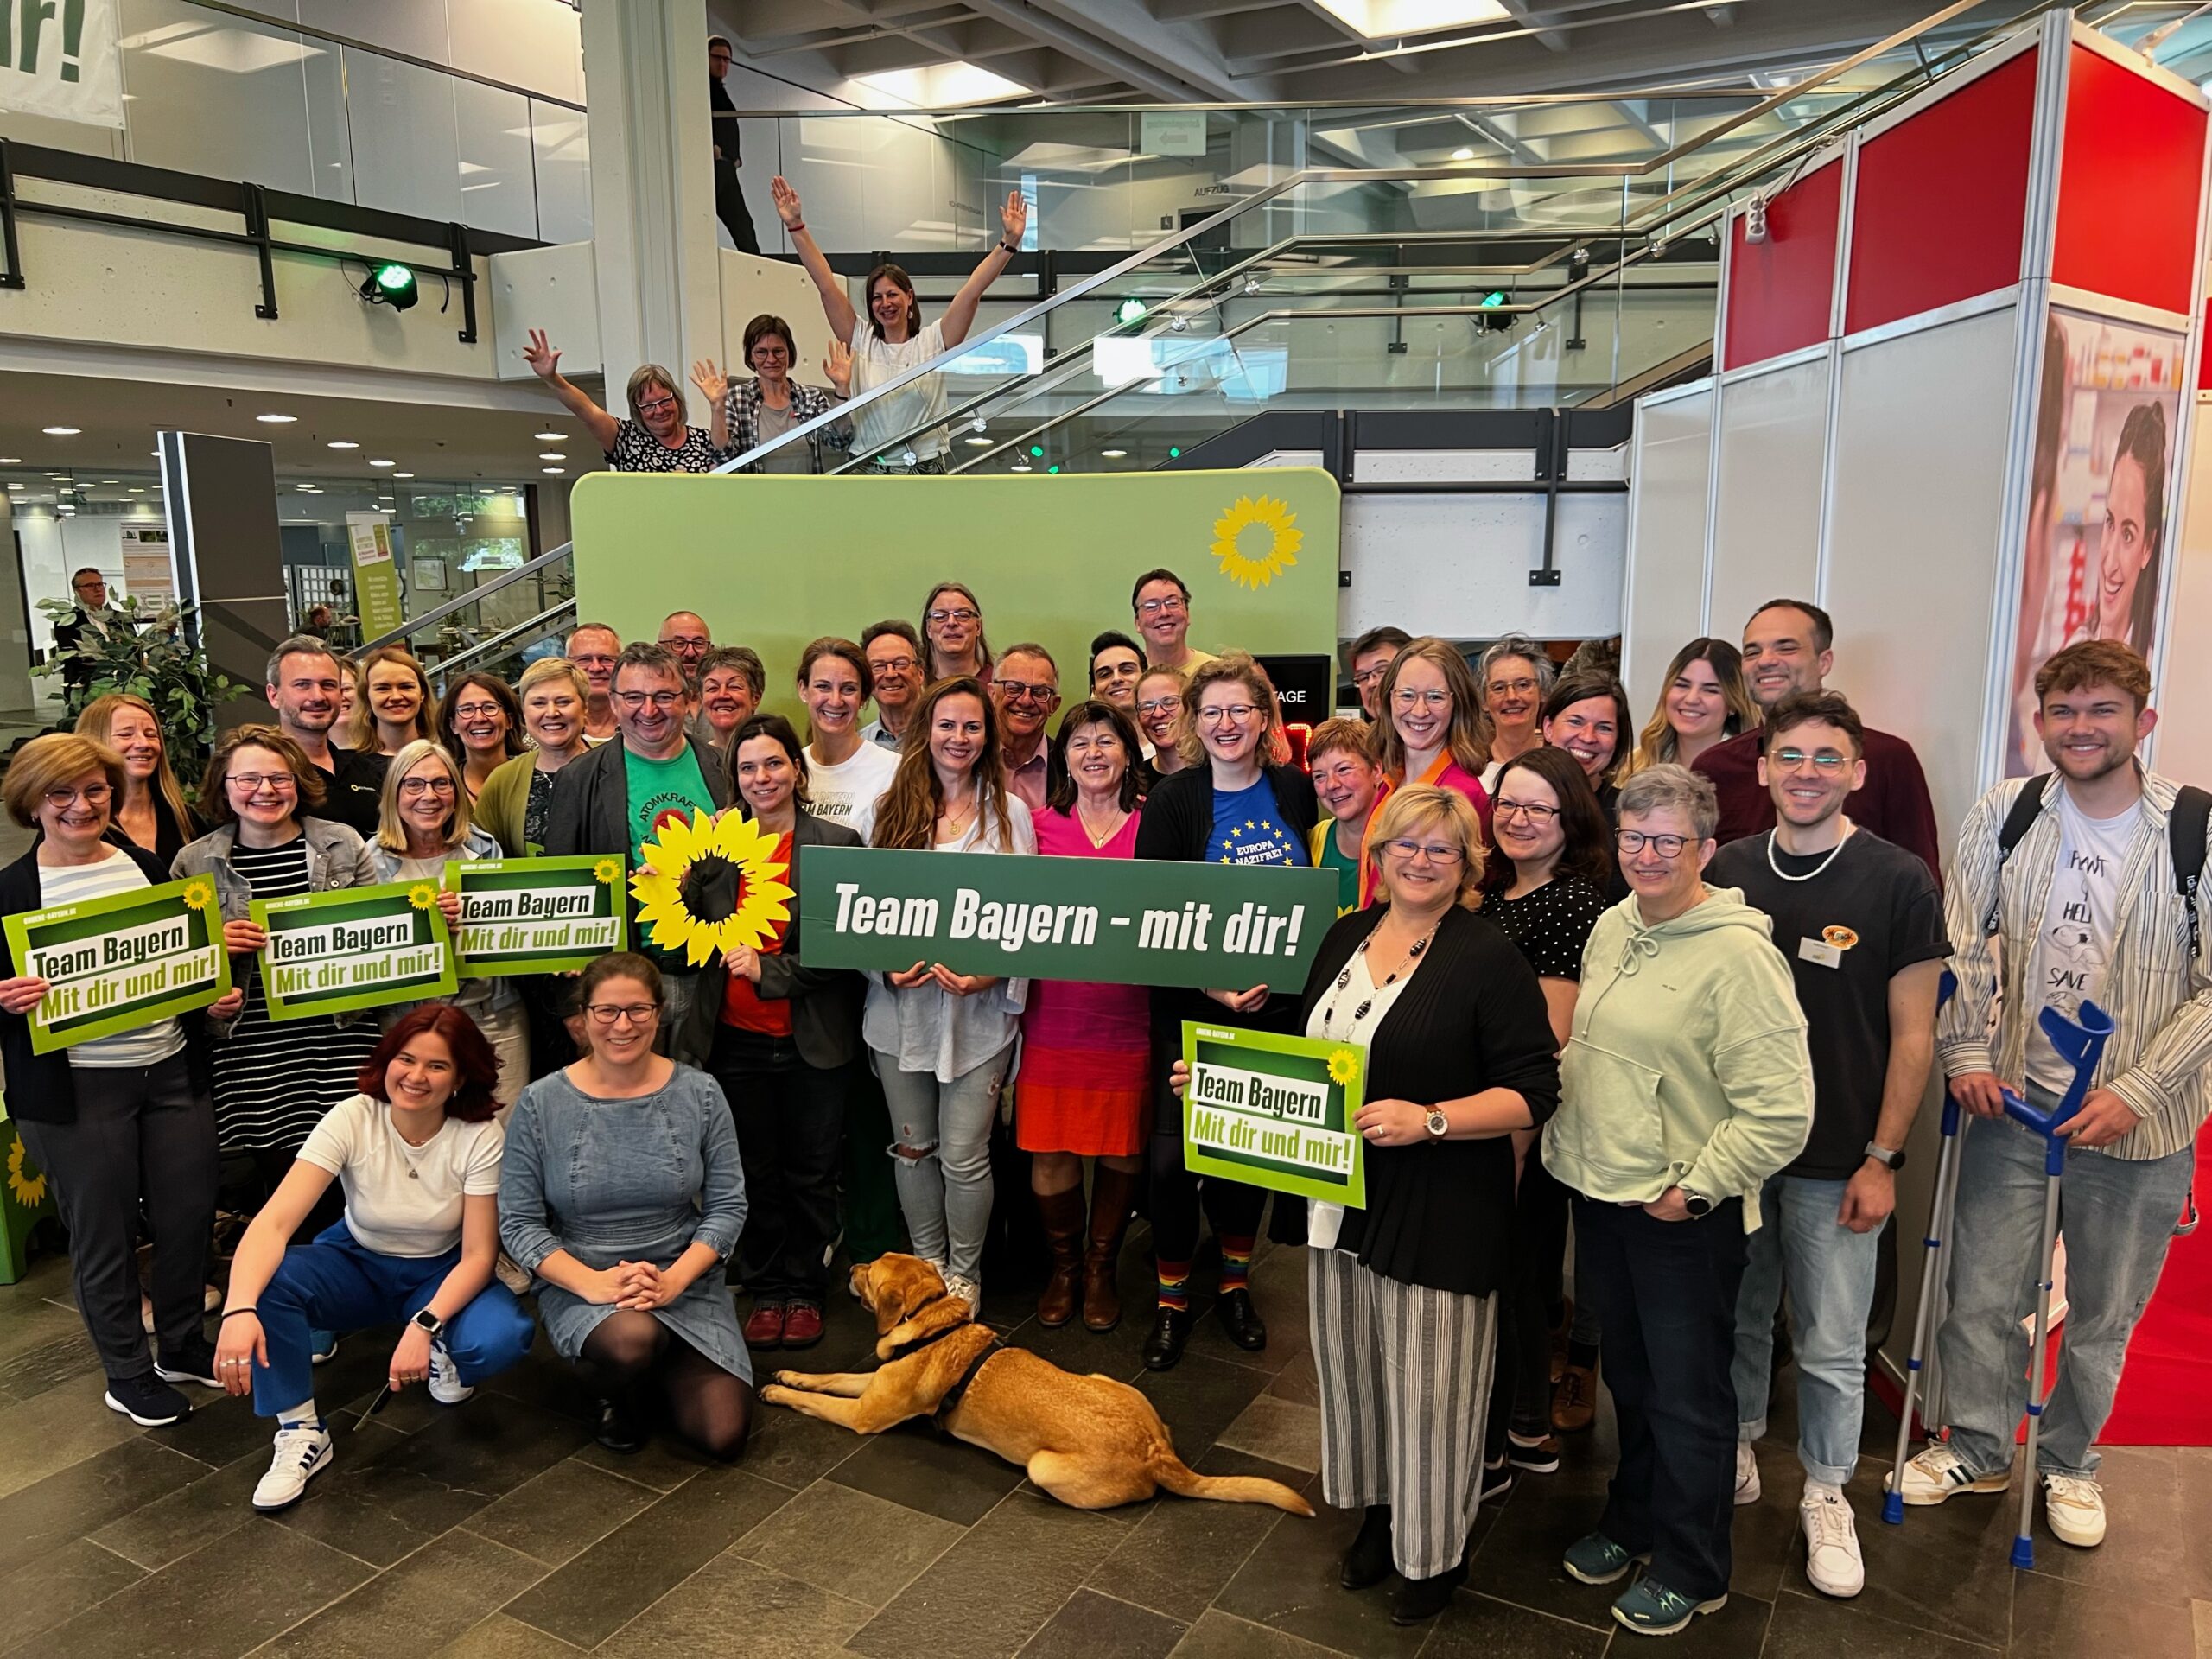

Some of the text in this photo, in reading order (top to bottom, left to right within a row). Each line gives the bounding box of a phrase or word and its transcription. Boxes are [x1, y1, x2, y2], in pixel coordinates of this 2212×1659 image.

[1194, 184, 1229, 196] AUFZUG
[817, 804, 853, 816] BAYERN
[1235, 849, 1283, 864] NAZIFREI
[1236, 840, 1274, 855] EUROPA
[461, 893, 589, 919] Team Bayern
[836, 883, 939, 937] Team
[950, 888, 1099, 952] Bayern
[1138, 901, 1213, 951] mit
[1223, 902, 1305, 956] dir!
[270, 923, 408, 959] Team Bayern
[461, 920, 617, 951] Mit dir und mir!
[33, 926, 183, 979] Team Bayern
[42, 949, 216, 1021] Mit dir und mir!
[276, 946, 440, 994] Mit dir und mir!
[2047, 968, 2088, 990] SAVE
[1197, 1067, 1321, 1119] Team Bayern
[1193, 1110, 1351, 1169] Mit dir und mir!
